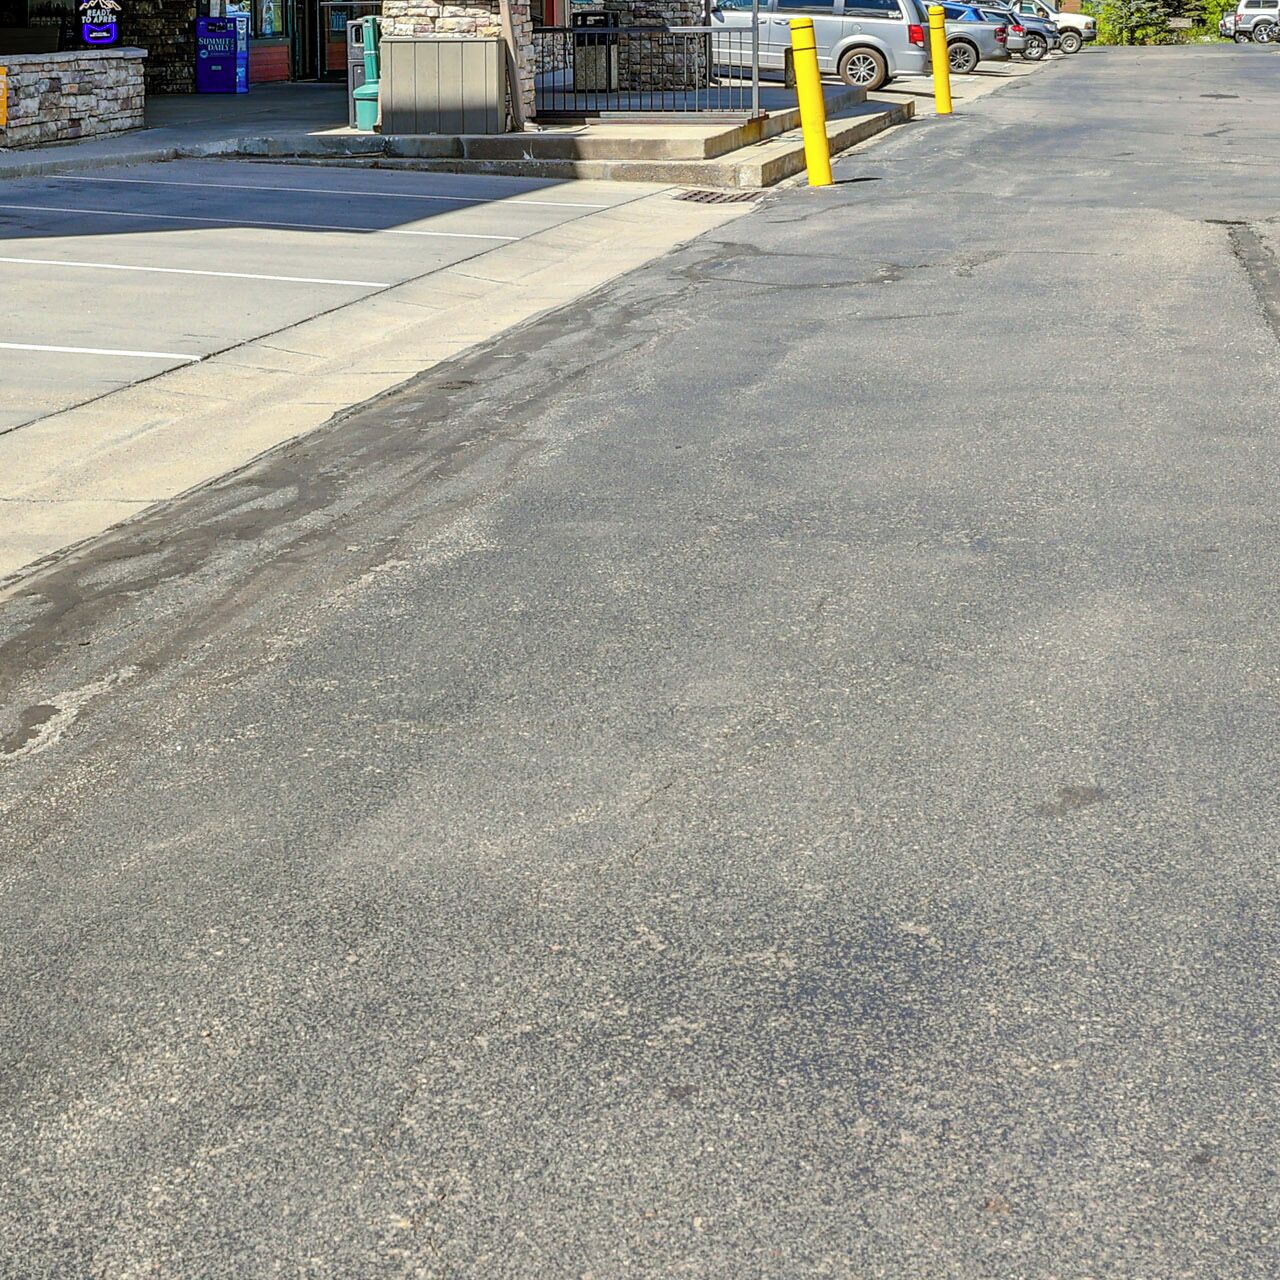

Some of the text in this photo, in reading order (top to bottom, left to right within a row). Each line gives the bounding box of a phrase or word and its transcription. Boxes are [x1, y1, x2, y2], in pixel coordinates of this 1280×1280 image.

[87, 9, 111, 17] READY
[199, 37, 230, 45] SUMMIT
[207, 43, 229, 51] DAILY
